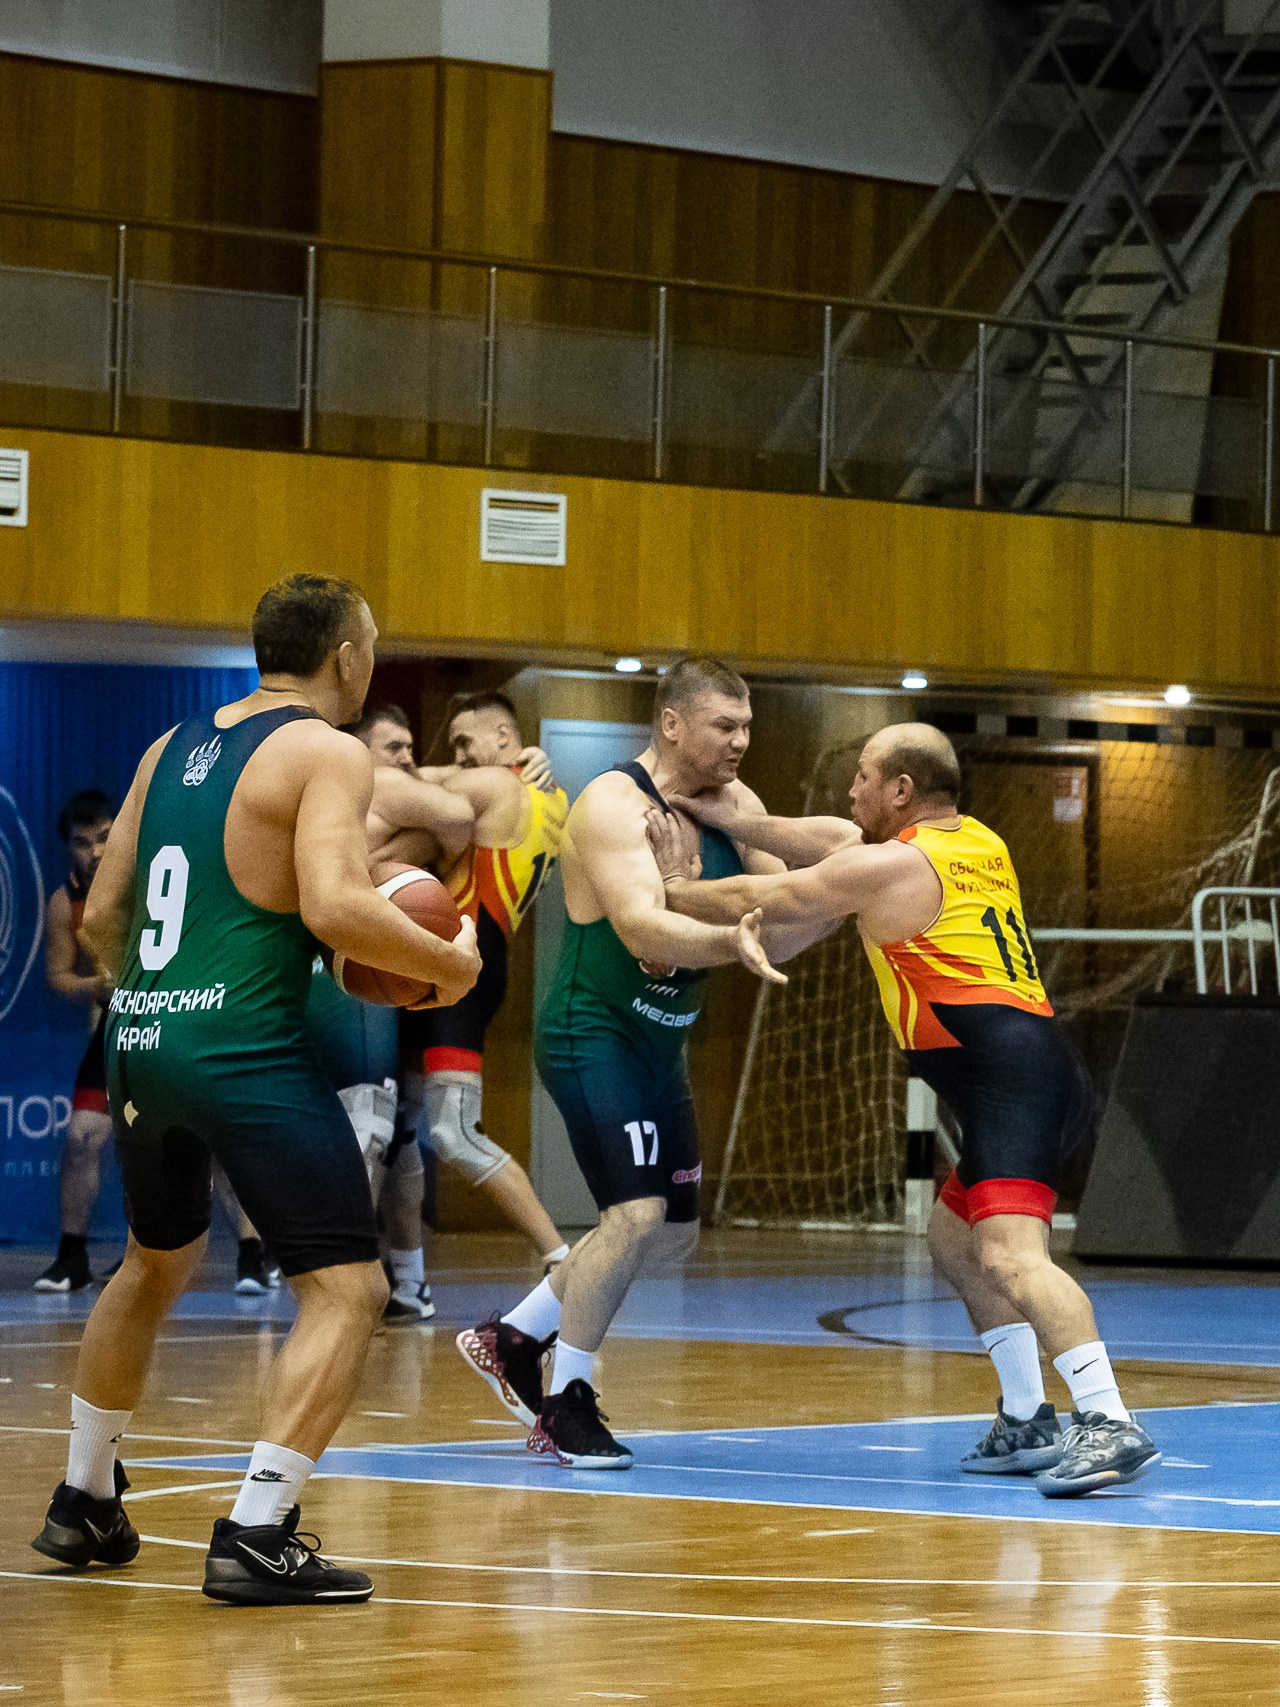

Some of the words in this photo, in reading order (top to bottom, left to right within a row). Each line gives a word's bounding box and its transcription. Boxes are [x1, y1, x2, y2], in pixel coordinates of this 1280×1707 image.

[139, 845, 189, 970] 9
[981, 906, 1038, 982] 11
[117, 1020, 161, 1051] КРАЙ
[624, 1120, 659, 1166] 17
